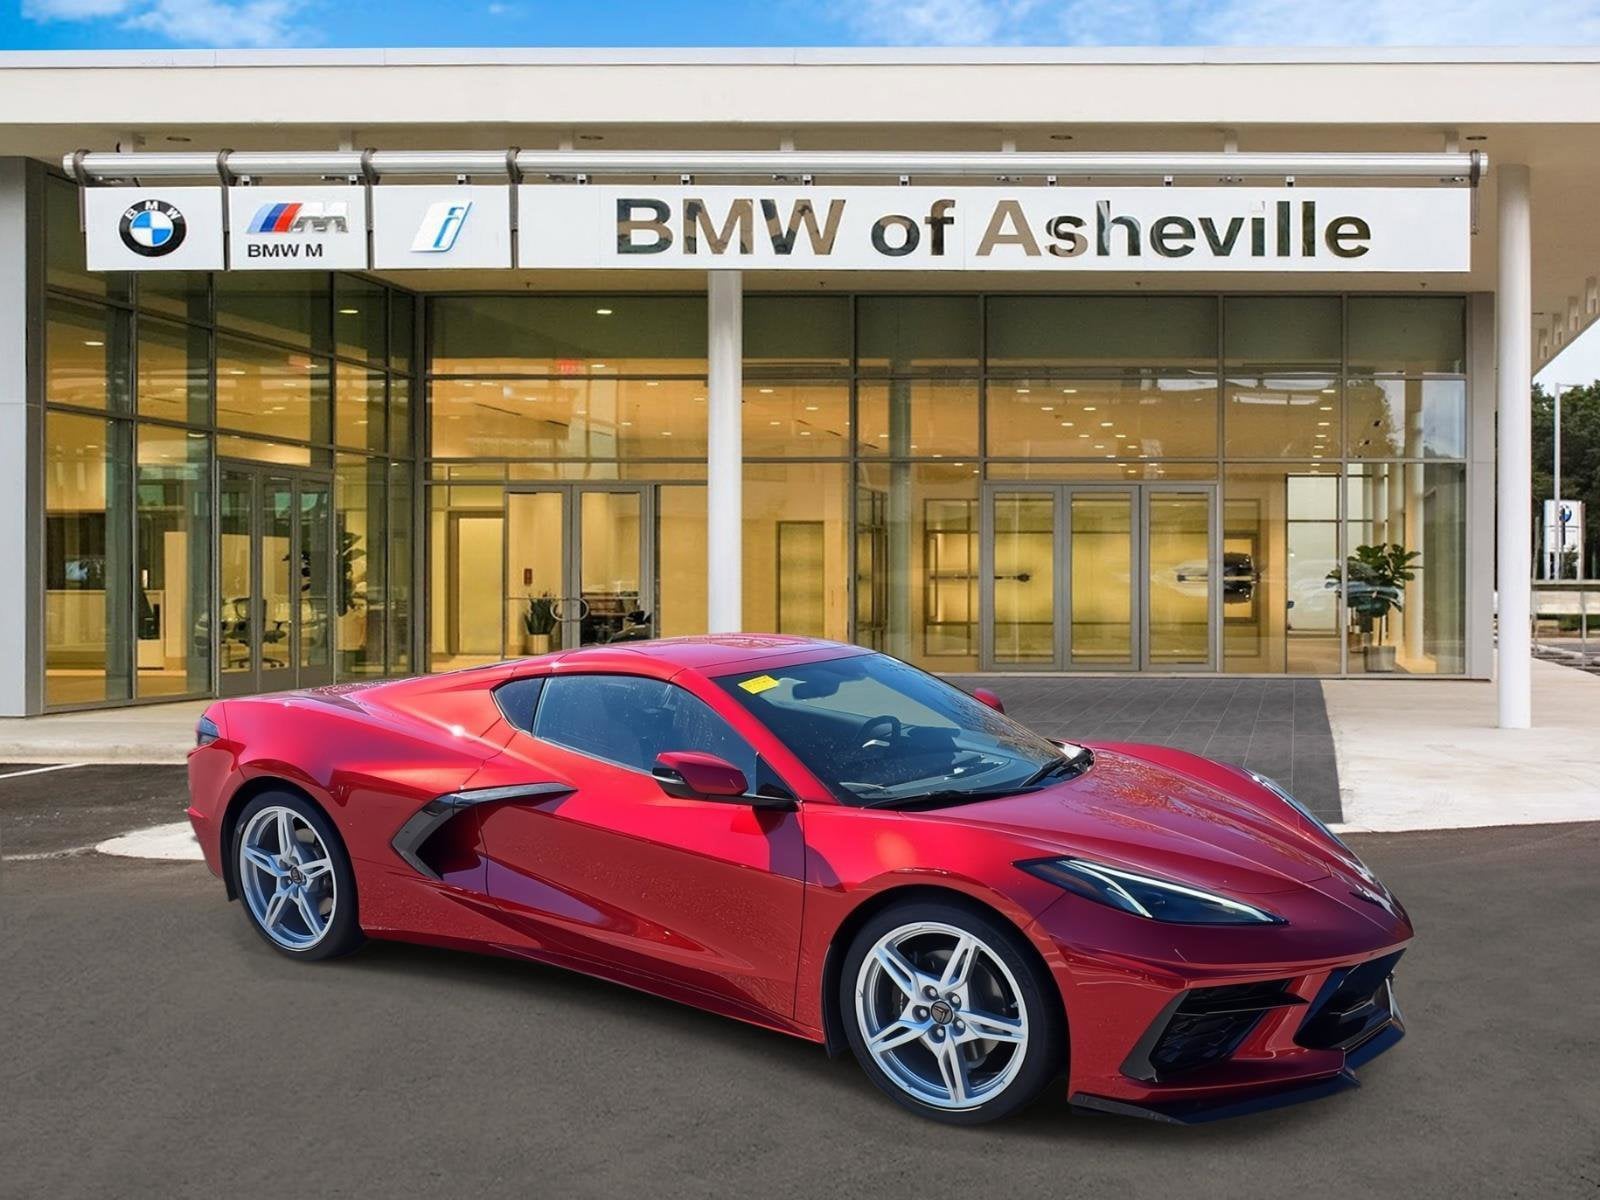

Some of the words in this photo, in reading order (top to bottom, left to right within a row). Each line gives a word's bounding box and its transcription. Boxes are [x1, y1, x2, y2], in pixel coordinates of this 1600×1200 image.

[125, 200, 181, 220] BMW
[616, 198, 846, 256] BMW
[870, 199, 956, 257] of
[975, 199, 1372, 258] Asheville
[247, 243, 300, 258] BMW
[305, 243, 323, 257] M
